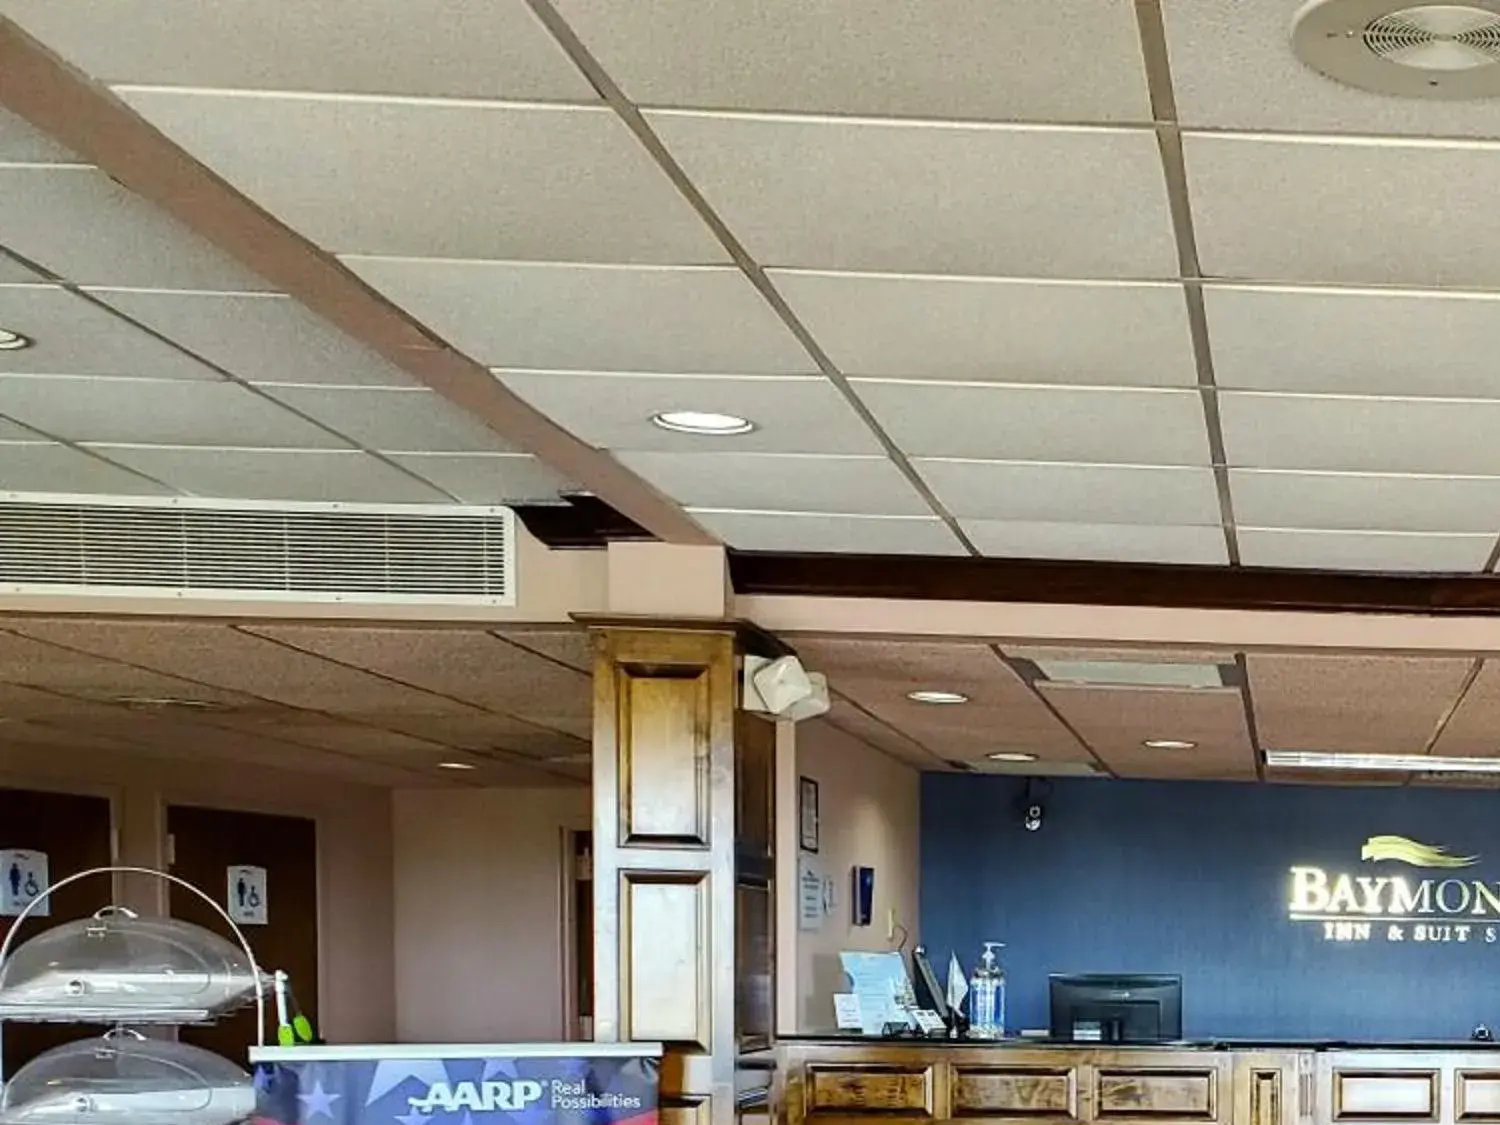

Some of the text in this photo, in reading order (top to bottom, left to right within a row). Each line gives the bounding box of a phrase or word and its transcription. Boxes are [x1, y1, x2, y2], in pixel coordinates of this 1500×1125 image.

[1323, 923, 1370, 941] INN
[1388, 924, 1404, 941] &
[408, 1081, 541, 1112] AARP
[552, 1080, 585, 1095] Real
